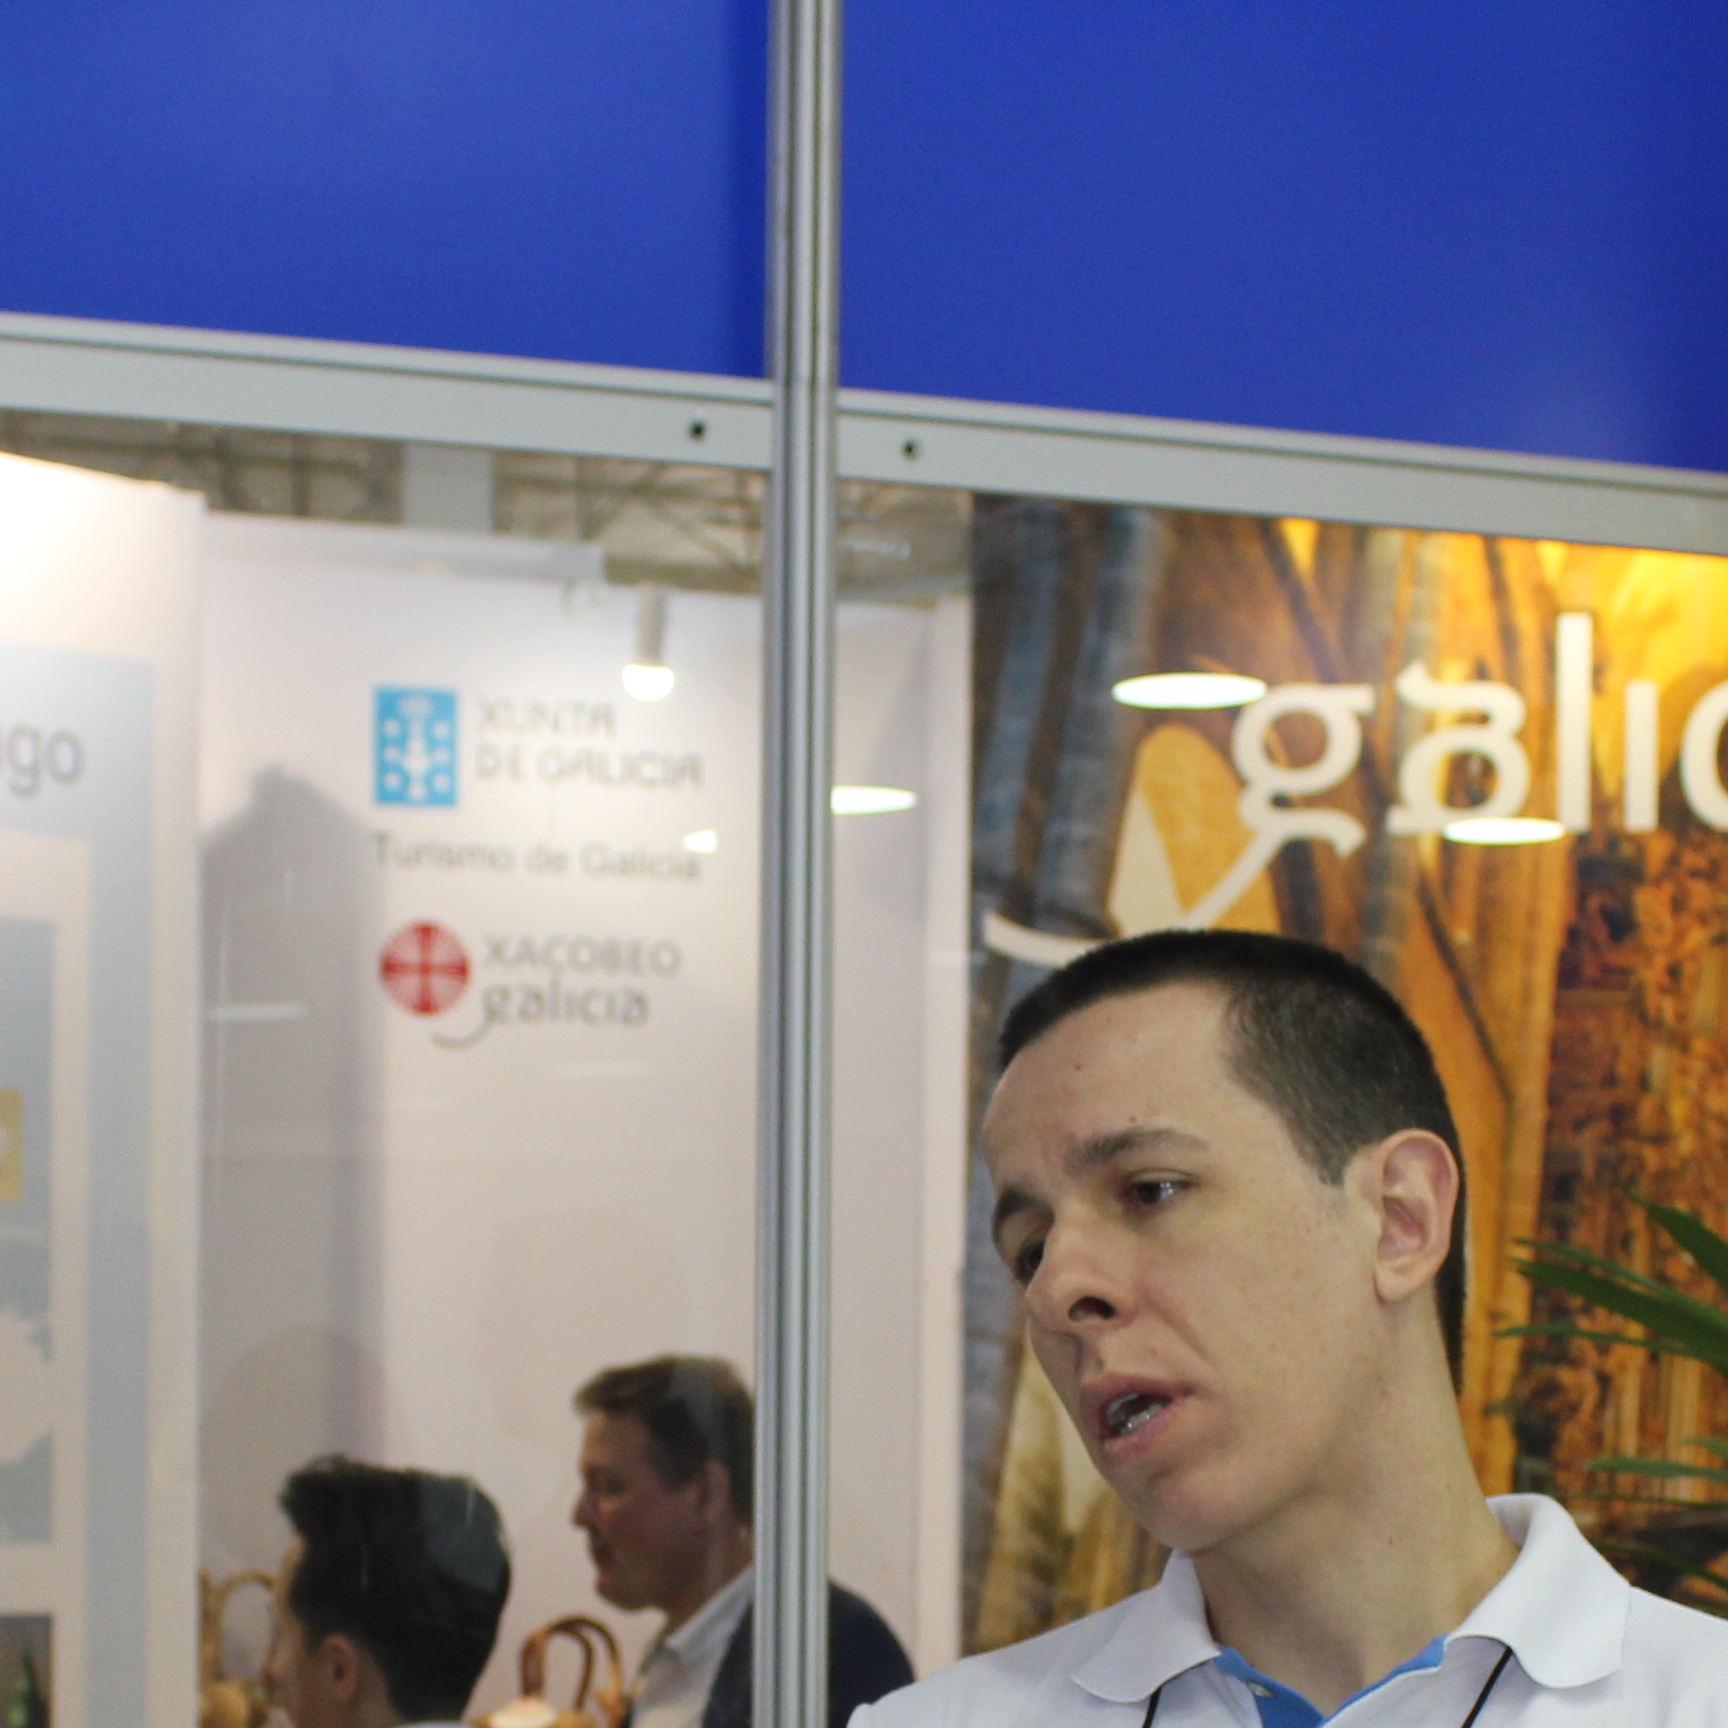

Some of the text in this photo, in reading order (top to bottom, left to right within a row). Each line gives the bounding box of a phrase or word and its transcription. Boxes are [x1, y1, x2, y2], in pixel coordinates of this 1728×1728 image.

[536, 746, 705, 789] GALICIA
[375, 833, 515, 872] Turismo
[524, 843, 570, 875] de
[483, 934, 683, 977] XACOBEO
[450, 967, 652, 1045] galicia
